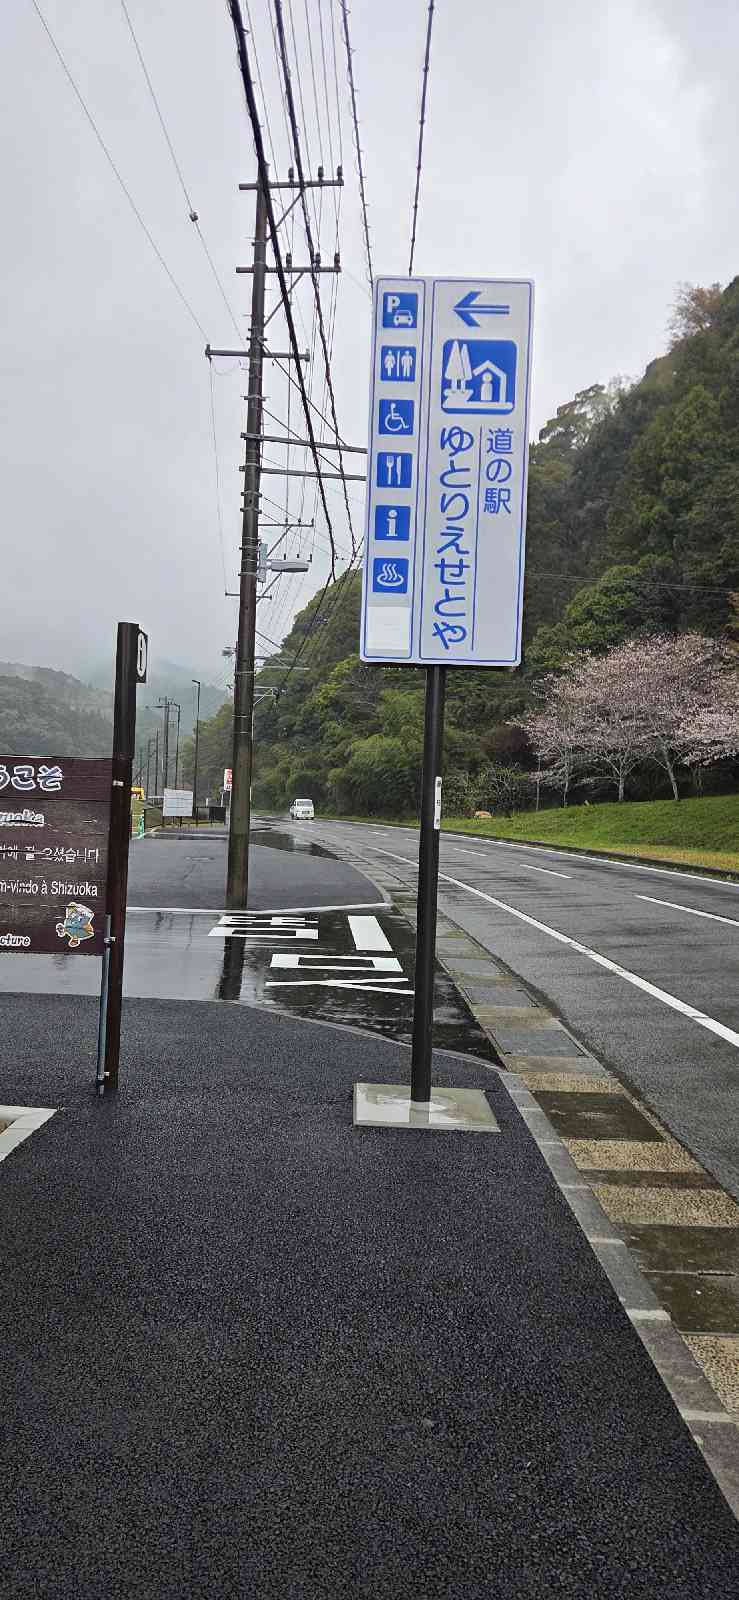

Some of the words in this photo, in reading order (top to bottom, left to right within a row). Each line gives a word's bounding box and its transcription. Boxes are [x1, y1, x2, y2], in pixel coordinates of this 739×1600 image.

[483, 428, 514, 515] 道の駅
[432, 426, 474, 650] ゆとりえせとや
[51, 881, 98, 897] Shizuoka
